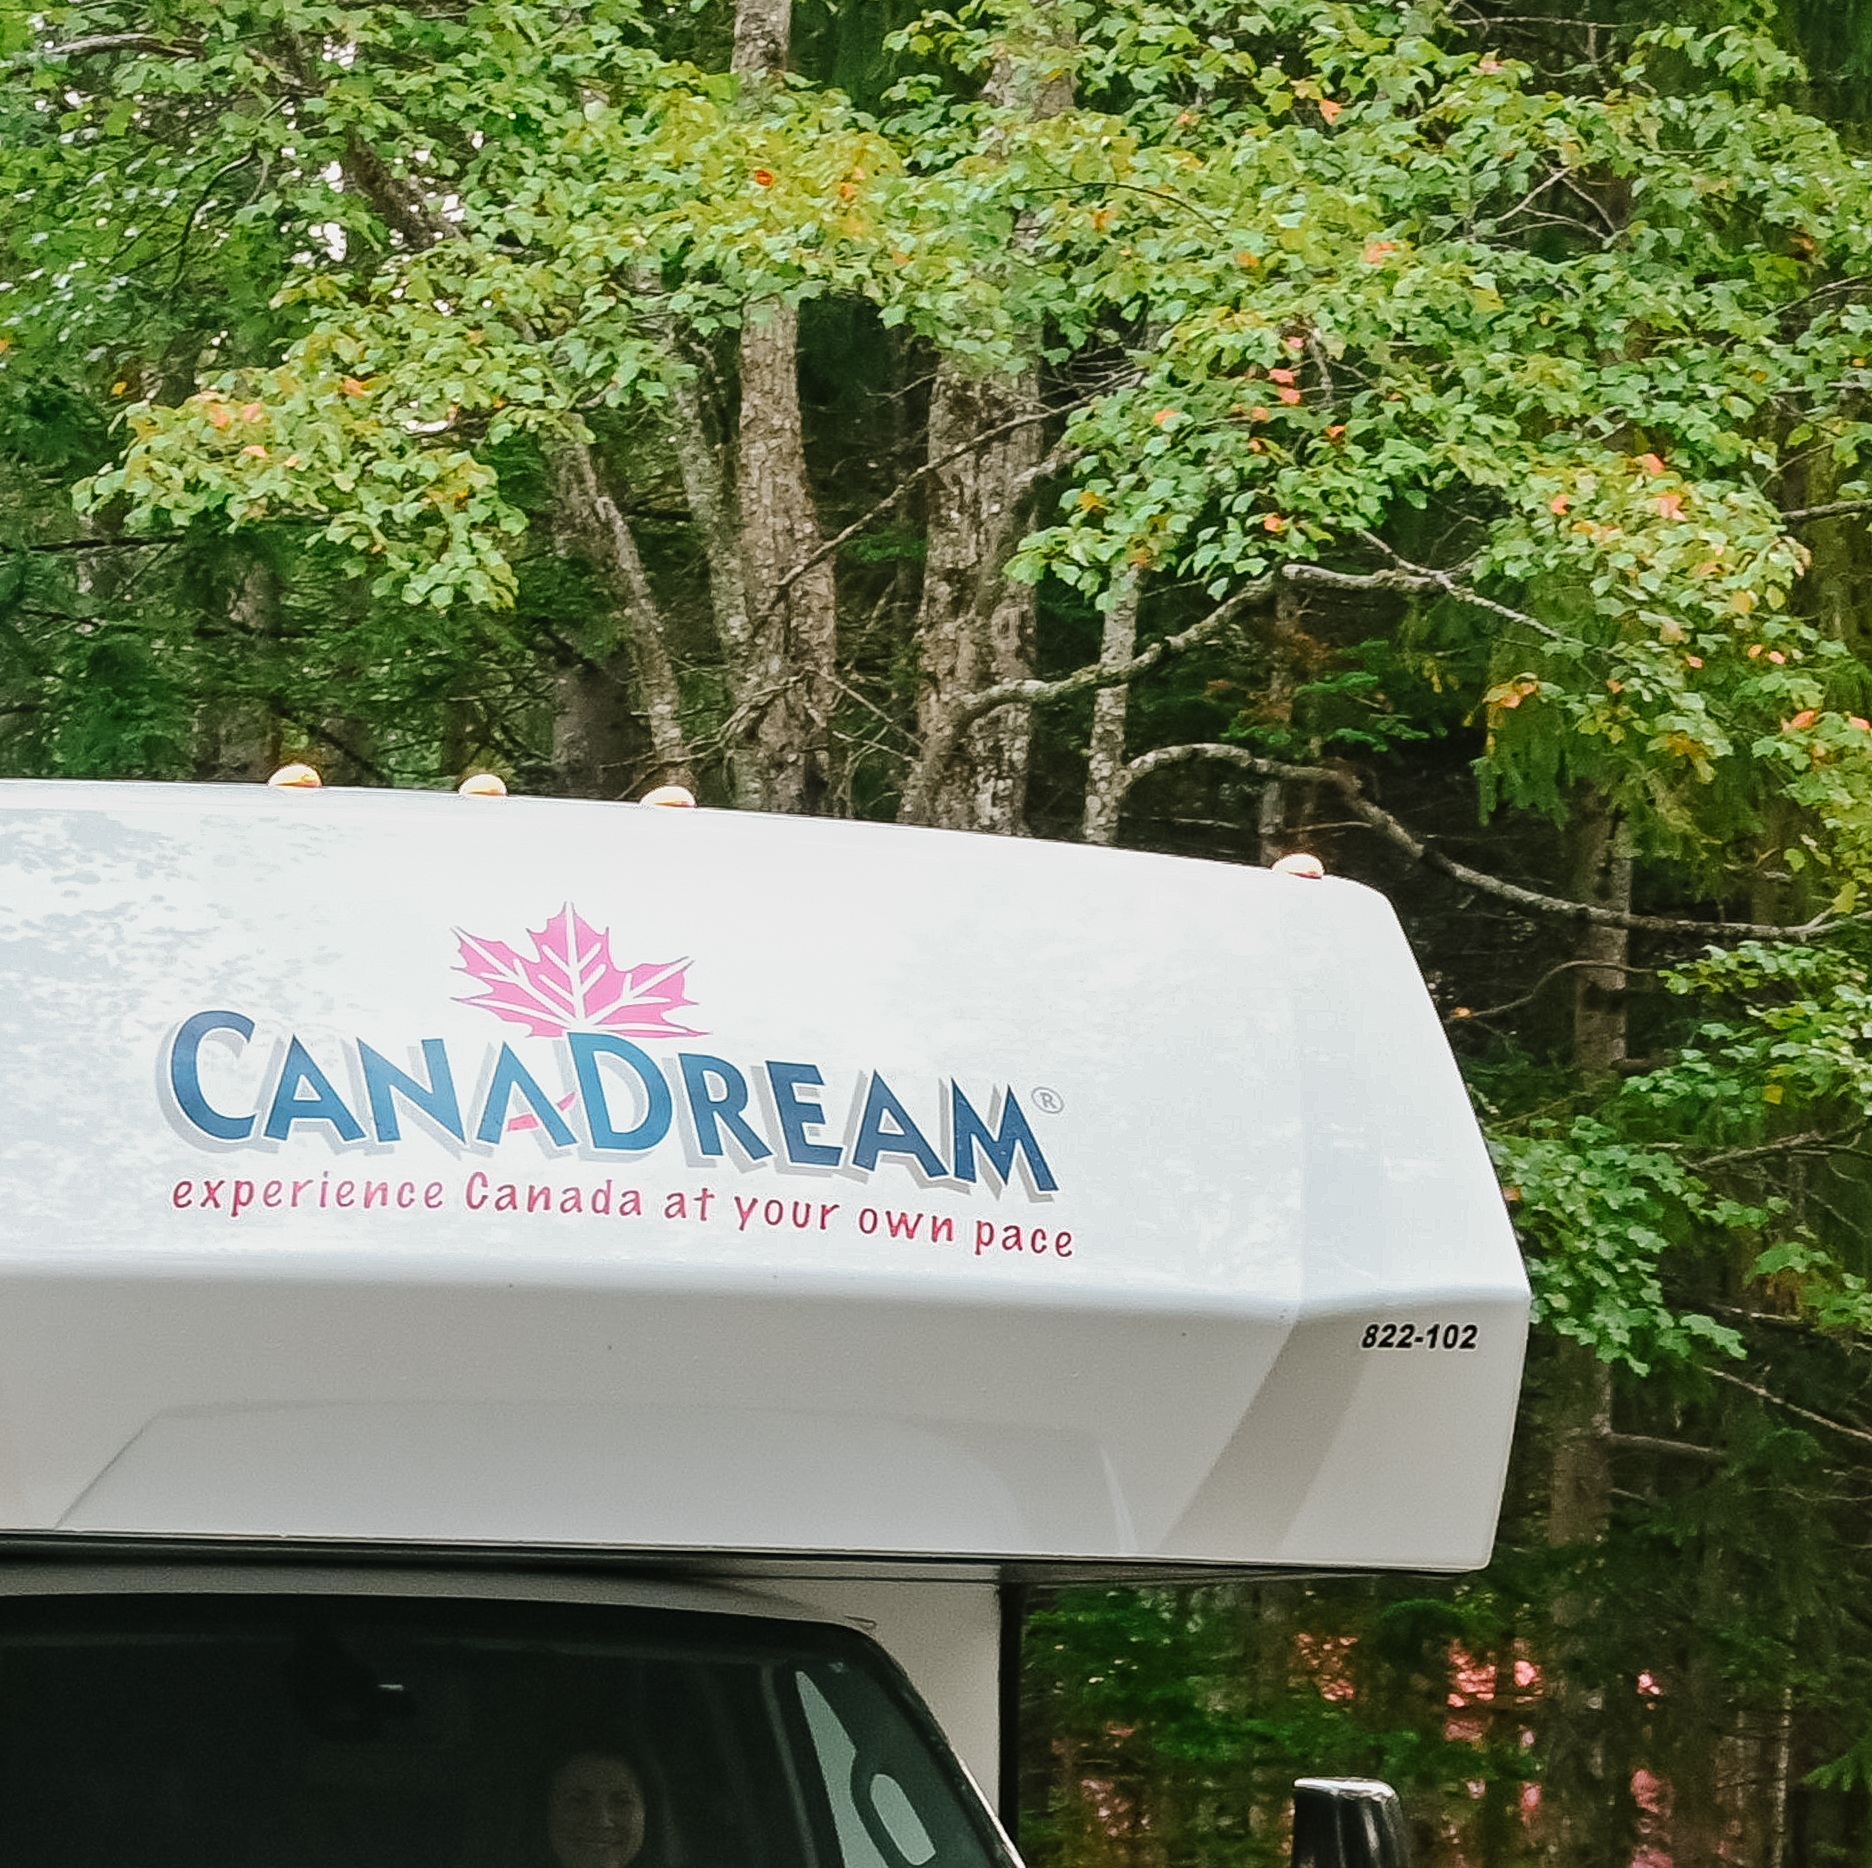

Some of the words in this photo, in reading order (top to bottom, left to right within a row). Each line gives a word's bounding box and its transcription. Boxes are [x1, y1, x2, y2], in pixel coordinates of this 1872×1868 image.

[172, 1170, 444, 1218] experience
[465, 1171, 644, 1216] Canada
[663, 1187, 716, 1222] at
[733, 1195, 841, 1231] your
[857, 1207, 956, 1243] own
[973, 1219, 1074, 1258] pace
[1361, 1323, 1478, 1350] 822-102
